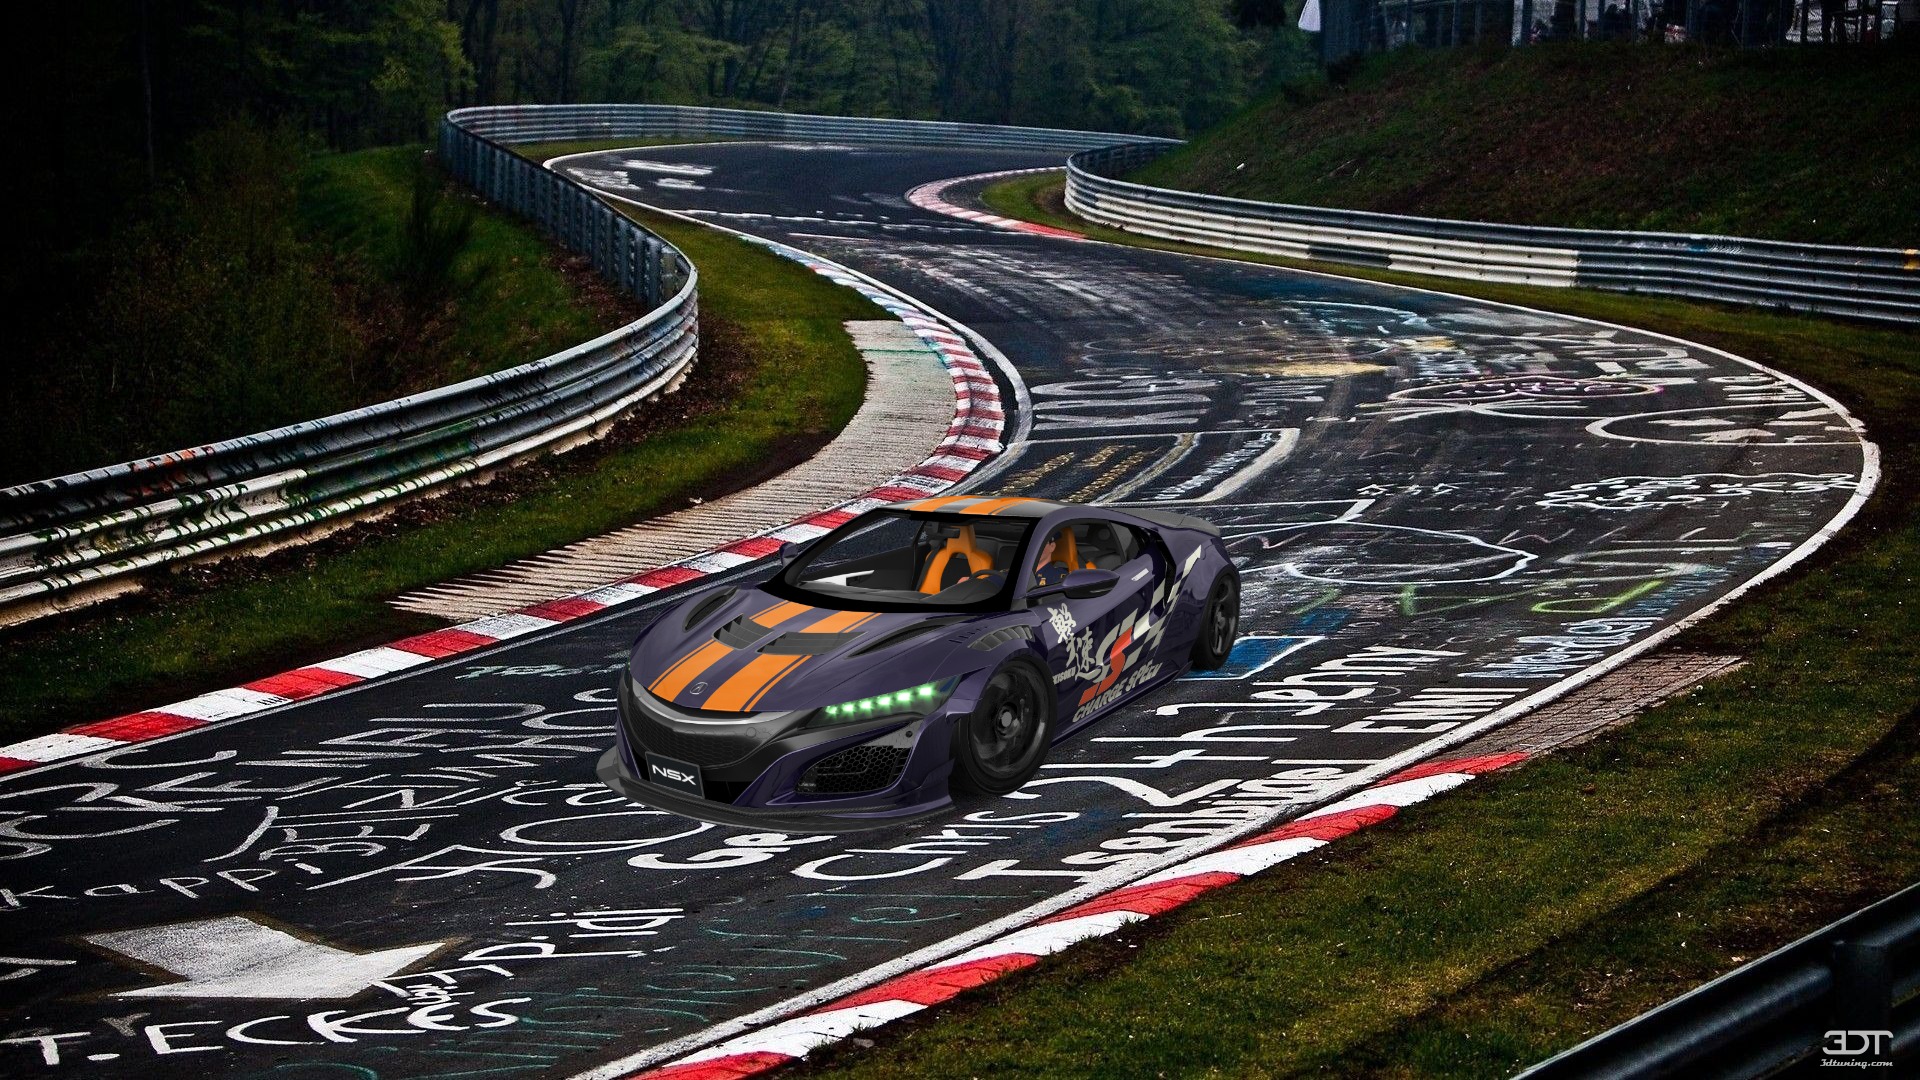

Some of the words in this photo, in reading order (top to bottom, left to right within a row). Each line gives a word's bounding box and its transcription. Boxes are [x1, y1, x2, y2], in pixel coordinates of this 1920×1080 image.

[1072, 677, 1129, 723] CHARGE
[651, 764, 697, 786] NSX
[791, 808, 1081, 881] Chris
